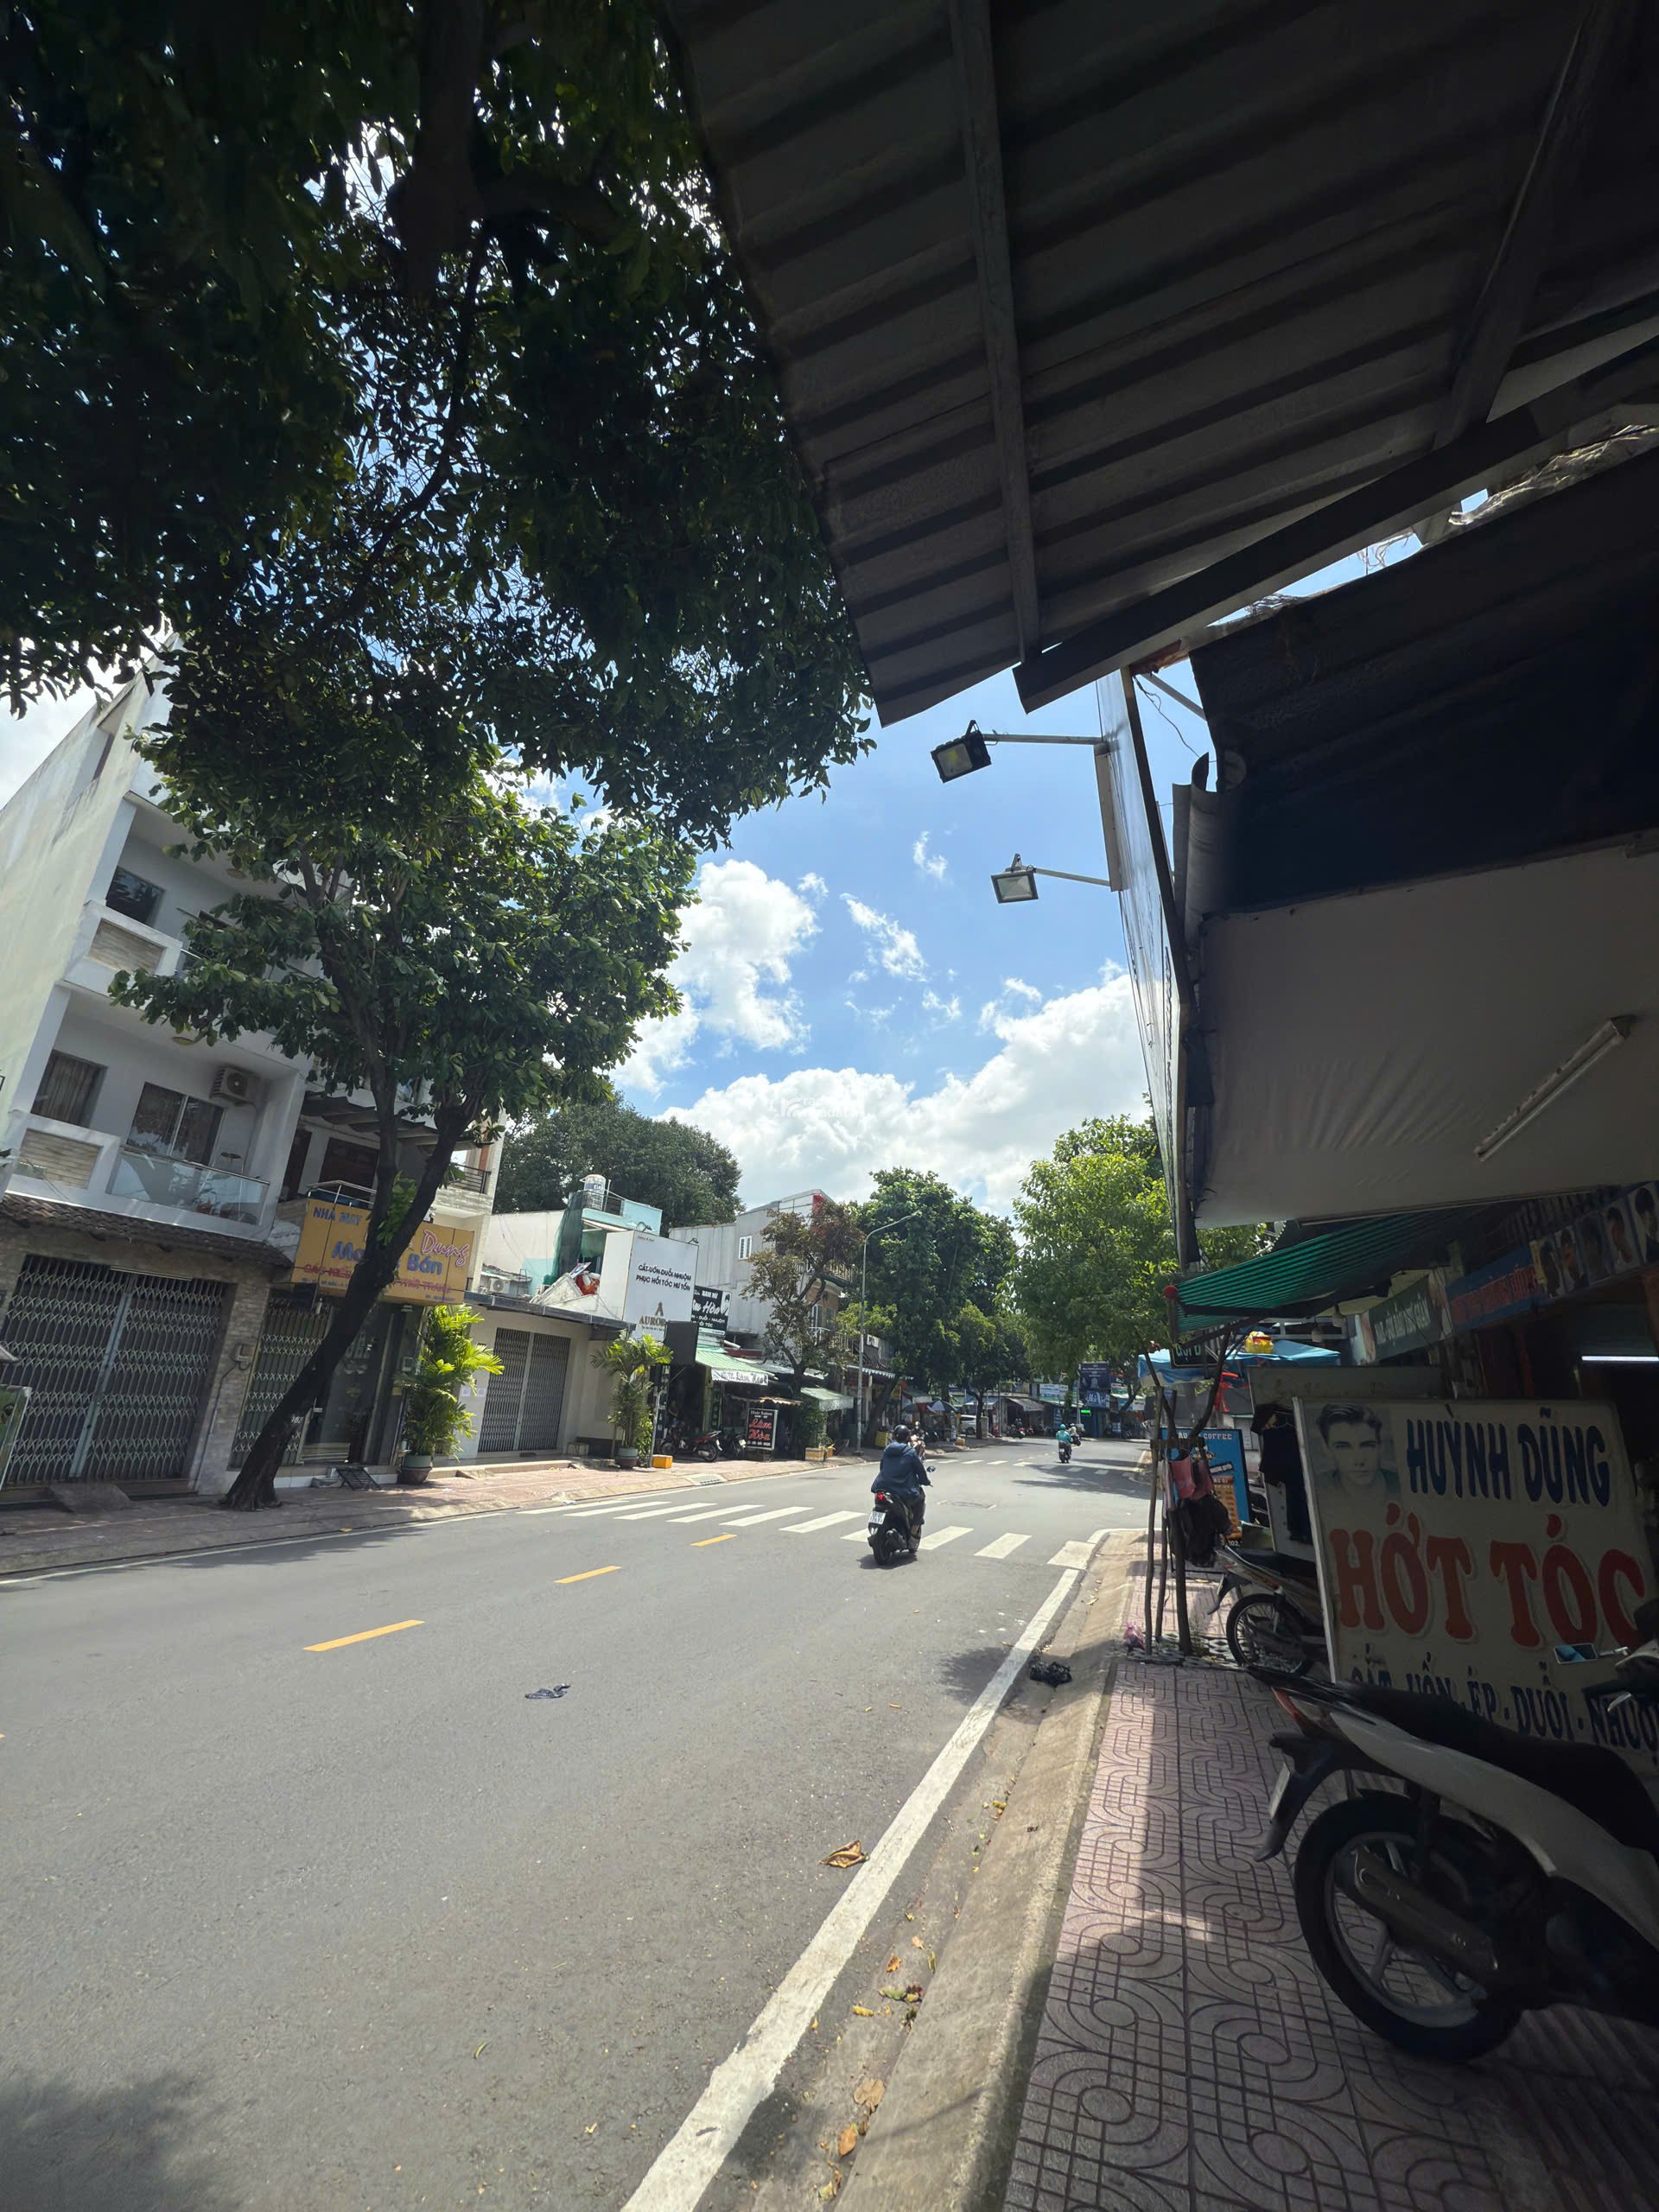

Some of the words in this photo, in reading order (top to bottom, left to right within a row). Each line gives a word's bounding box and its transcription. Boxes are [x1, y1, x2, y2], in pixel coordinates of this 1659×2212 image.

[661, 1279, 673, 1288] TÓC
[639, 1315, 667, 1327] AUROR
[1203, 1433, 1233, 1441] COFFEE
[1407, 1403, 1511, 1499] HUỲNH
[1517, 1407, 1610, 1507] DŨNG
[1330, 1503, 1473, 1640] HỚT
[1490, 1513, 1645, 1651] TÓC
